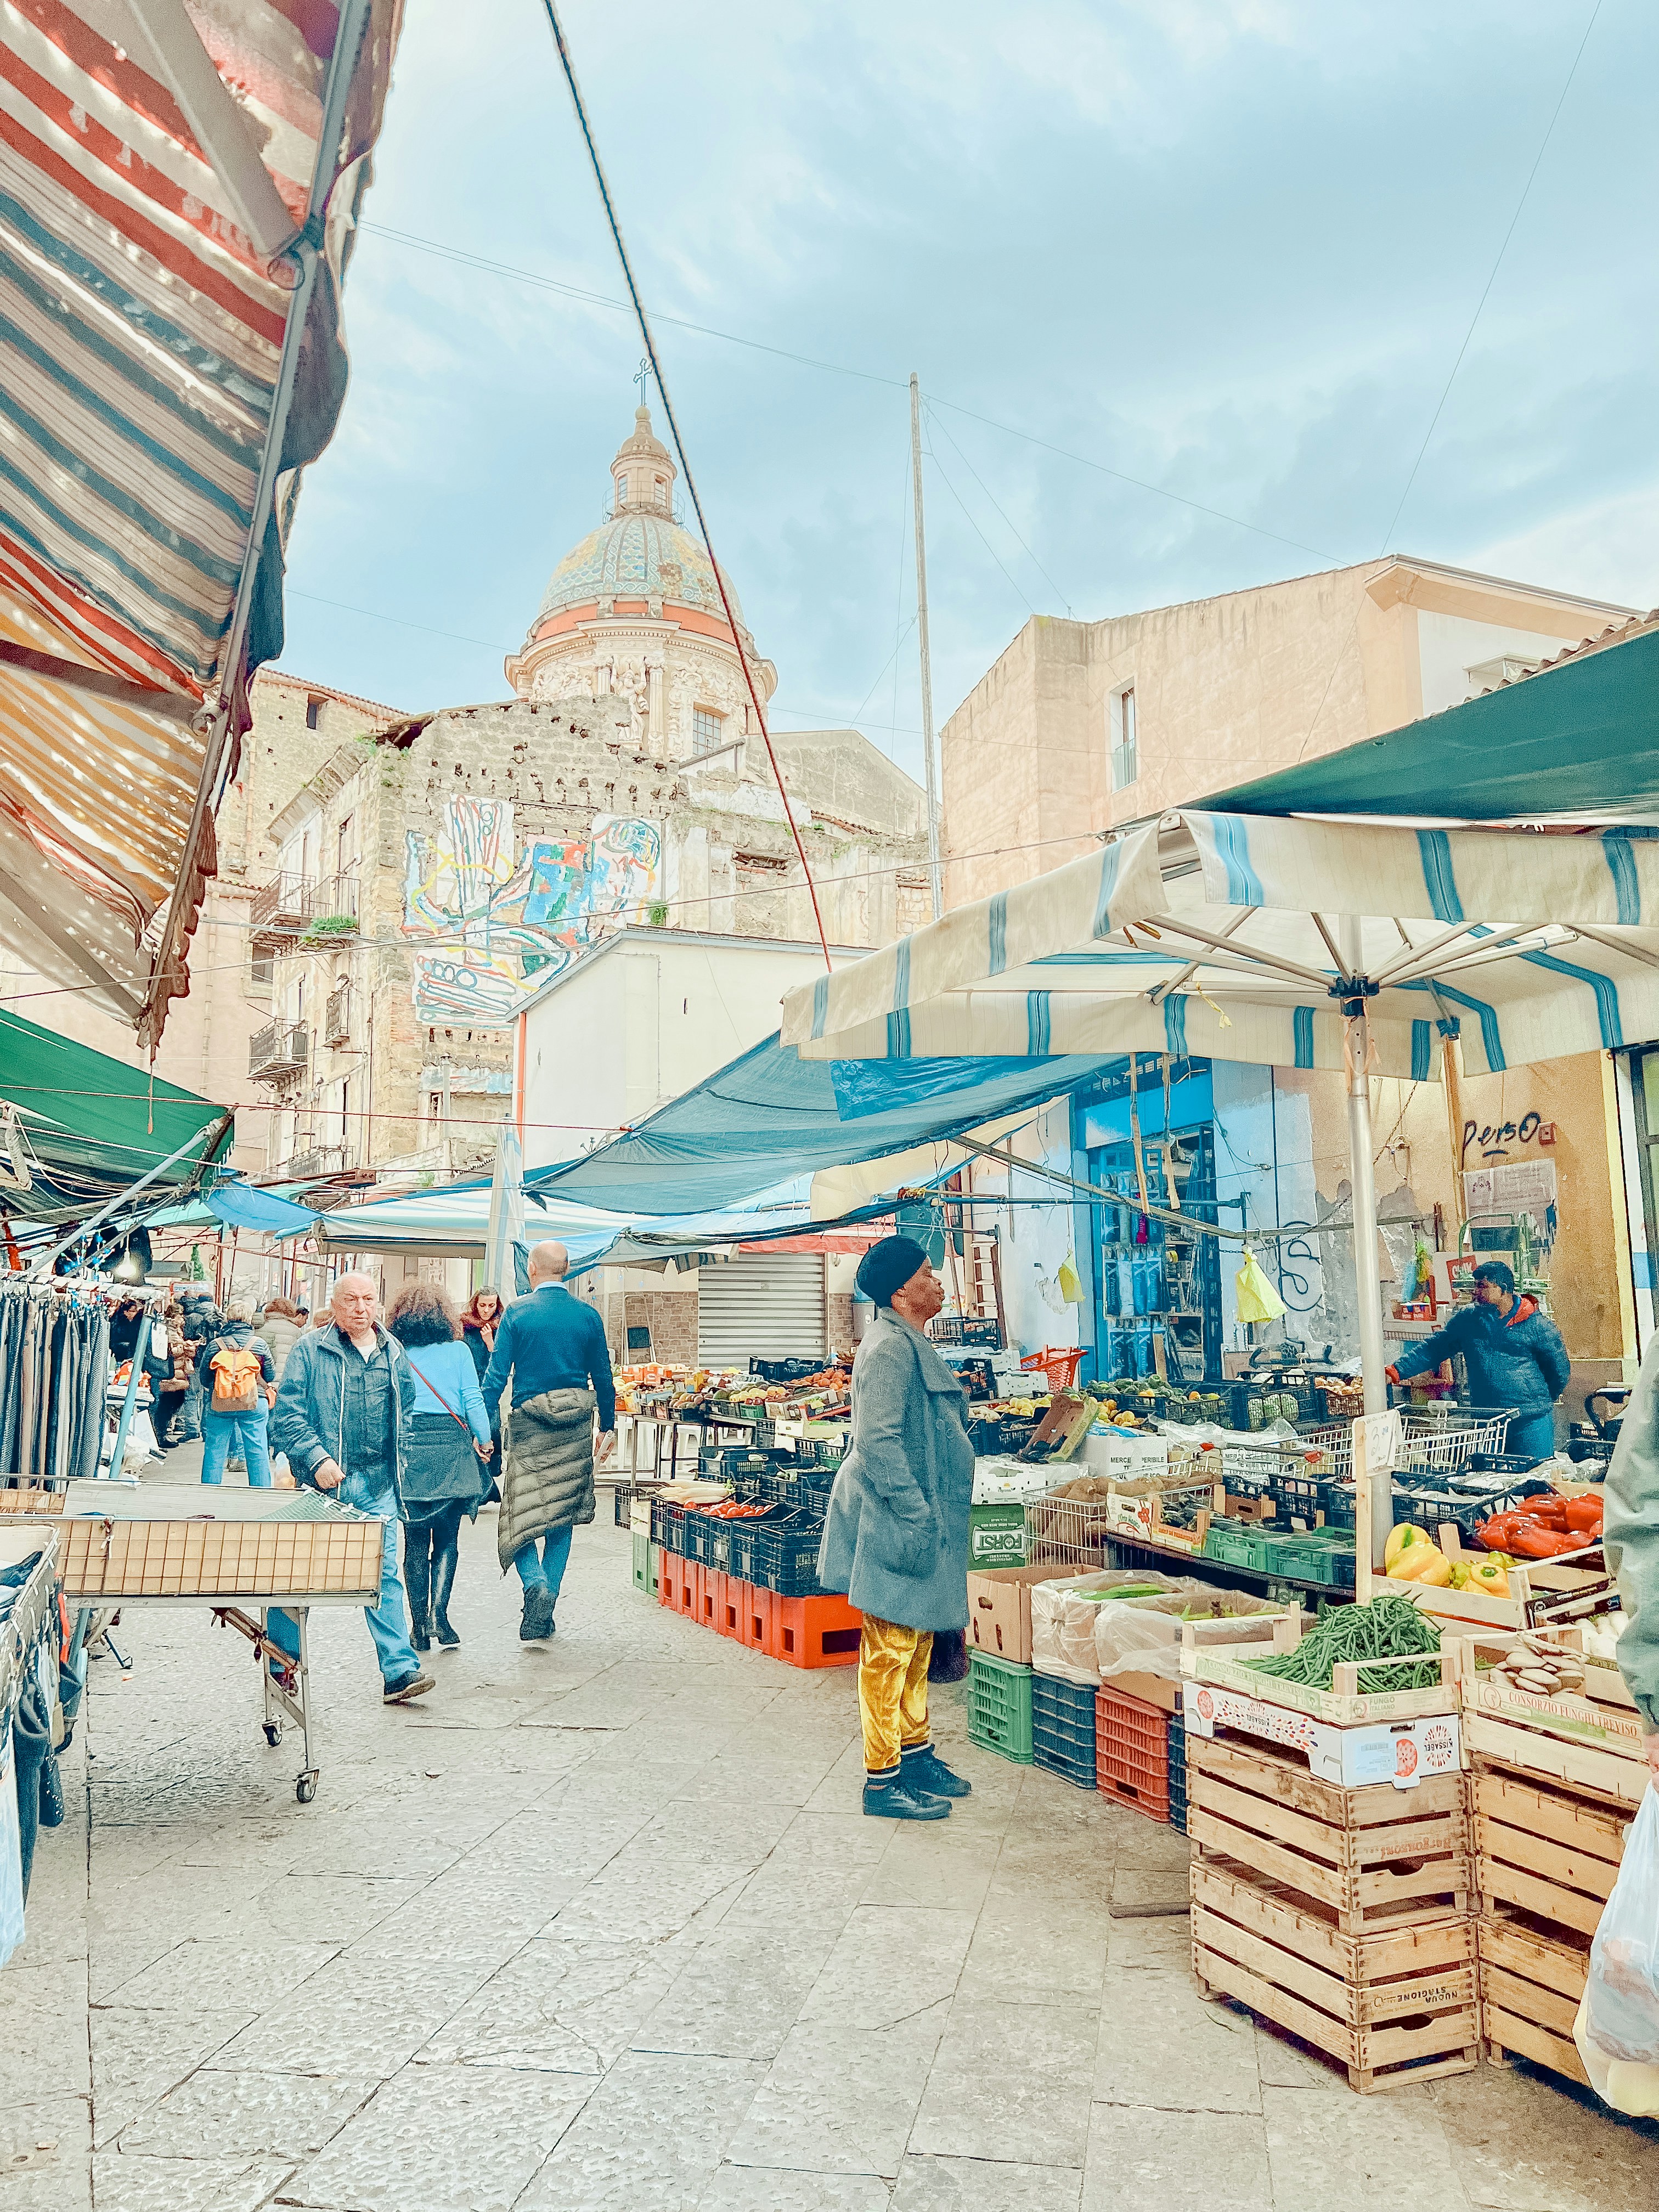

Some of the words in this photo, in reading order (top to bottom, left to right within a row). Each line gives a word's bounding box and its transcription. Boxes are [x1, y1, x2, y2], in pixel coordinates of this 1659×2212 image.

[977, 1533, 1022, 1551] FORST
[1209, 1660, 1245, 1678] CONSORZIO
[1247, 1672, 1273, 1688] FUNGHI
[1274, 1682, 1305, 1697] TREVISO
[1369, 1696, 1395, 1705] FUNGO
[1246, 1714, 1270, 1727] KISSABEL
[1509, 1691, 1558, 1714] CONSORZIO
[1560, 1705, 1595, 1726] FUNGHI
[1597, 1716, 1638, 1737] TREVISO
[1424, 1741, 1453, 1752] KISSABEL
[1397, 1987, 1446, 2002] STAGIONE
